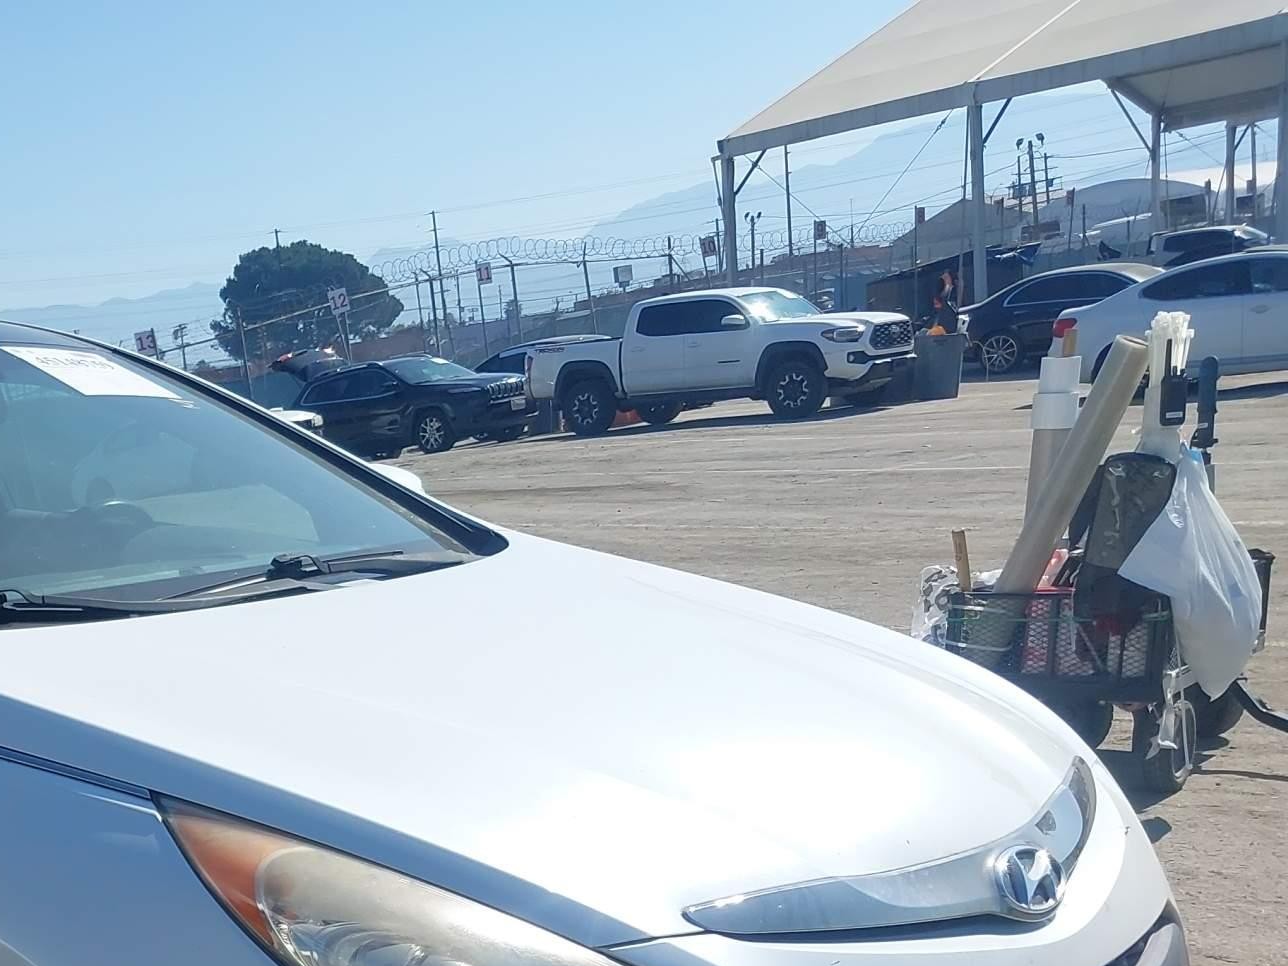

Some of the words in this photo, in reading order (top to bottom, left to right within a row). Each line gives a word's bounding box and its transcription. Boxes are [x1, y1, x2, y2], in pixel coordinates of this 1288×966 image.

[702, 239, 716, 254] 10
[476, 266, 491, 281] 11
[330, 293, 348, 310] 12
[136, 335, 155, 351] 13
